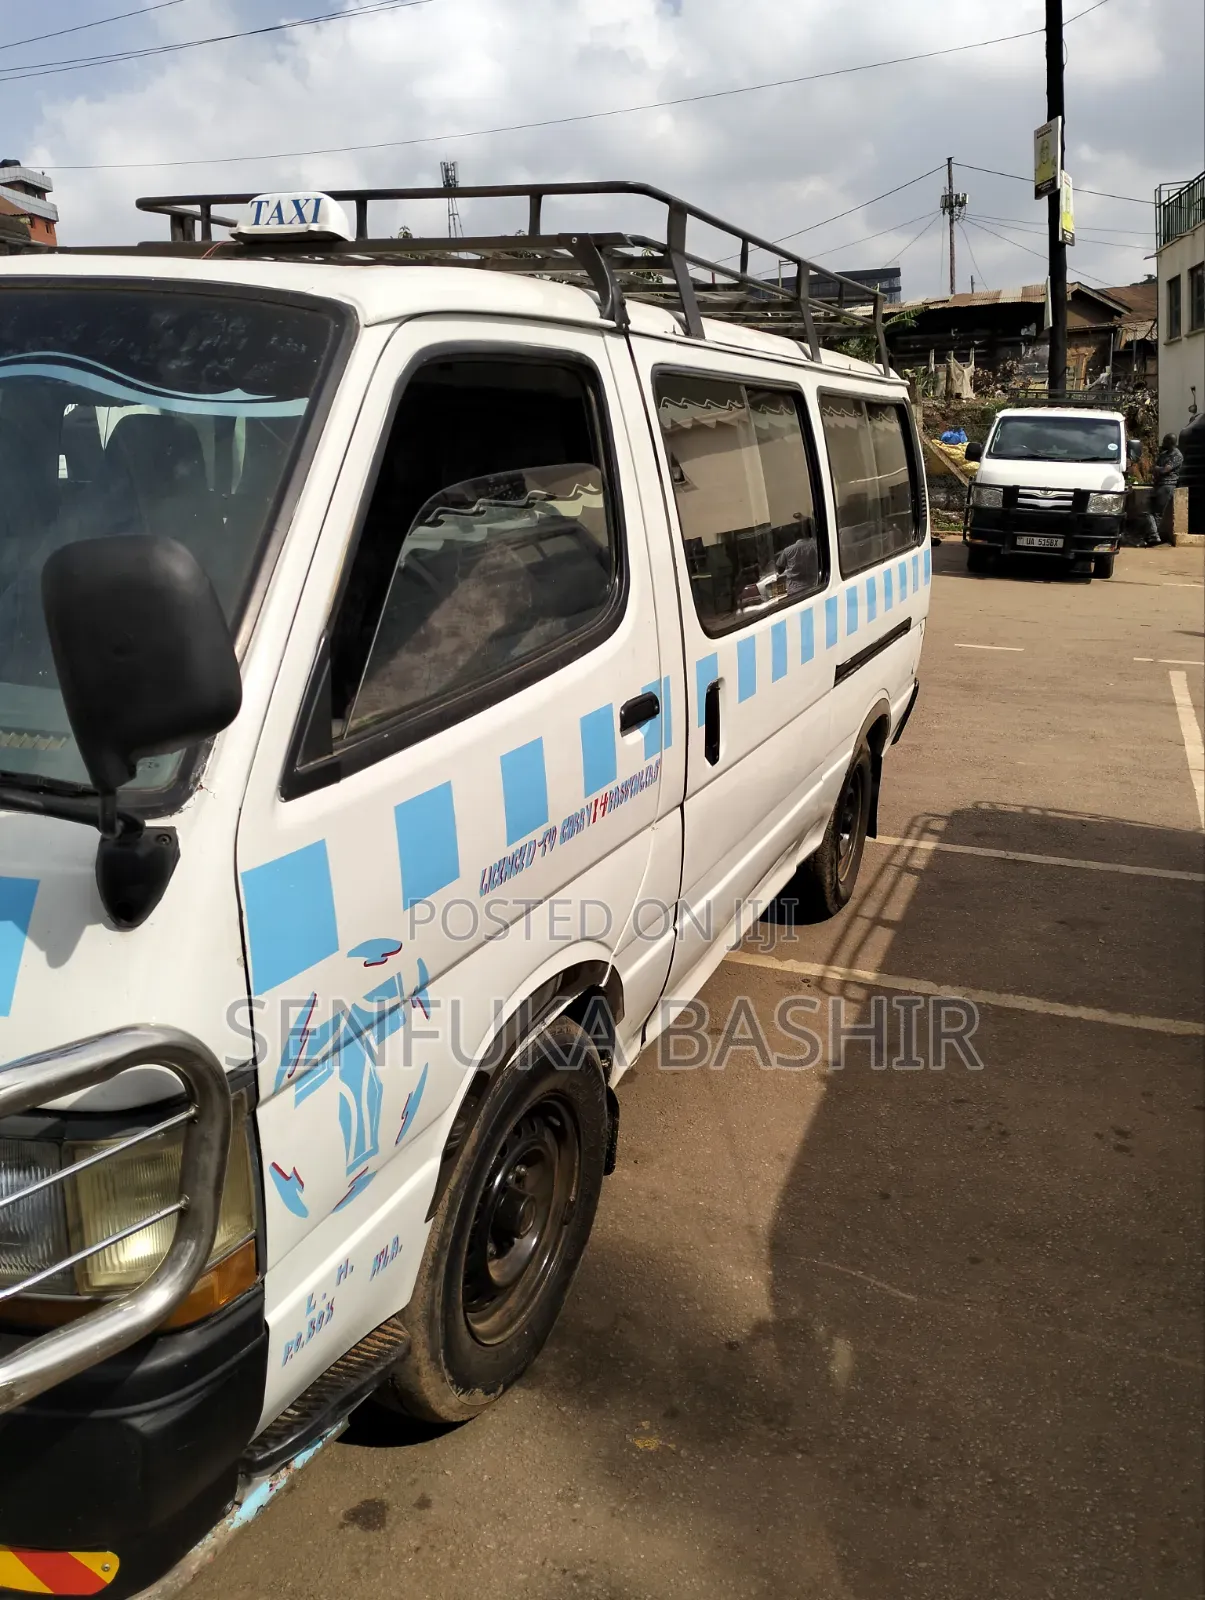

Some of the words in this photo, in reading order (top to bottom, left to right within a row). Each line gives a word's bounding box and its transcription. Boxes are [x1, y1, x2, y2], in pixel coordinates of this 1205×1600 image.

[250, 197, 325, 226] TAXI
[1026, 537, 1035, 546] UA
[559, 802, 593, 846] CARRY
[592, 791, 609, 824] 14
